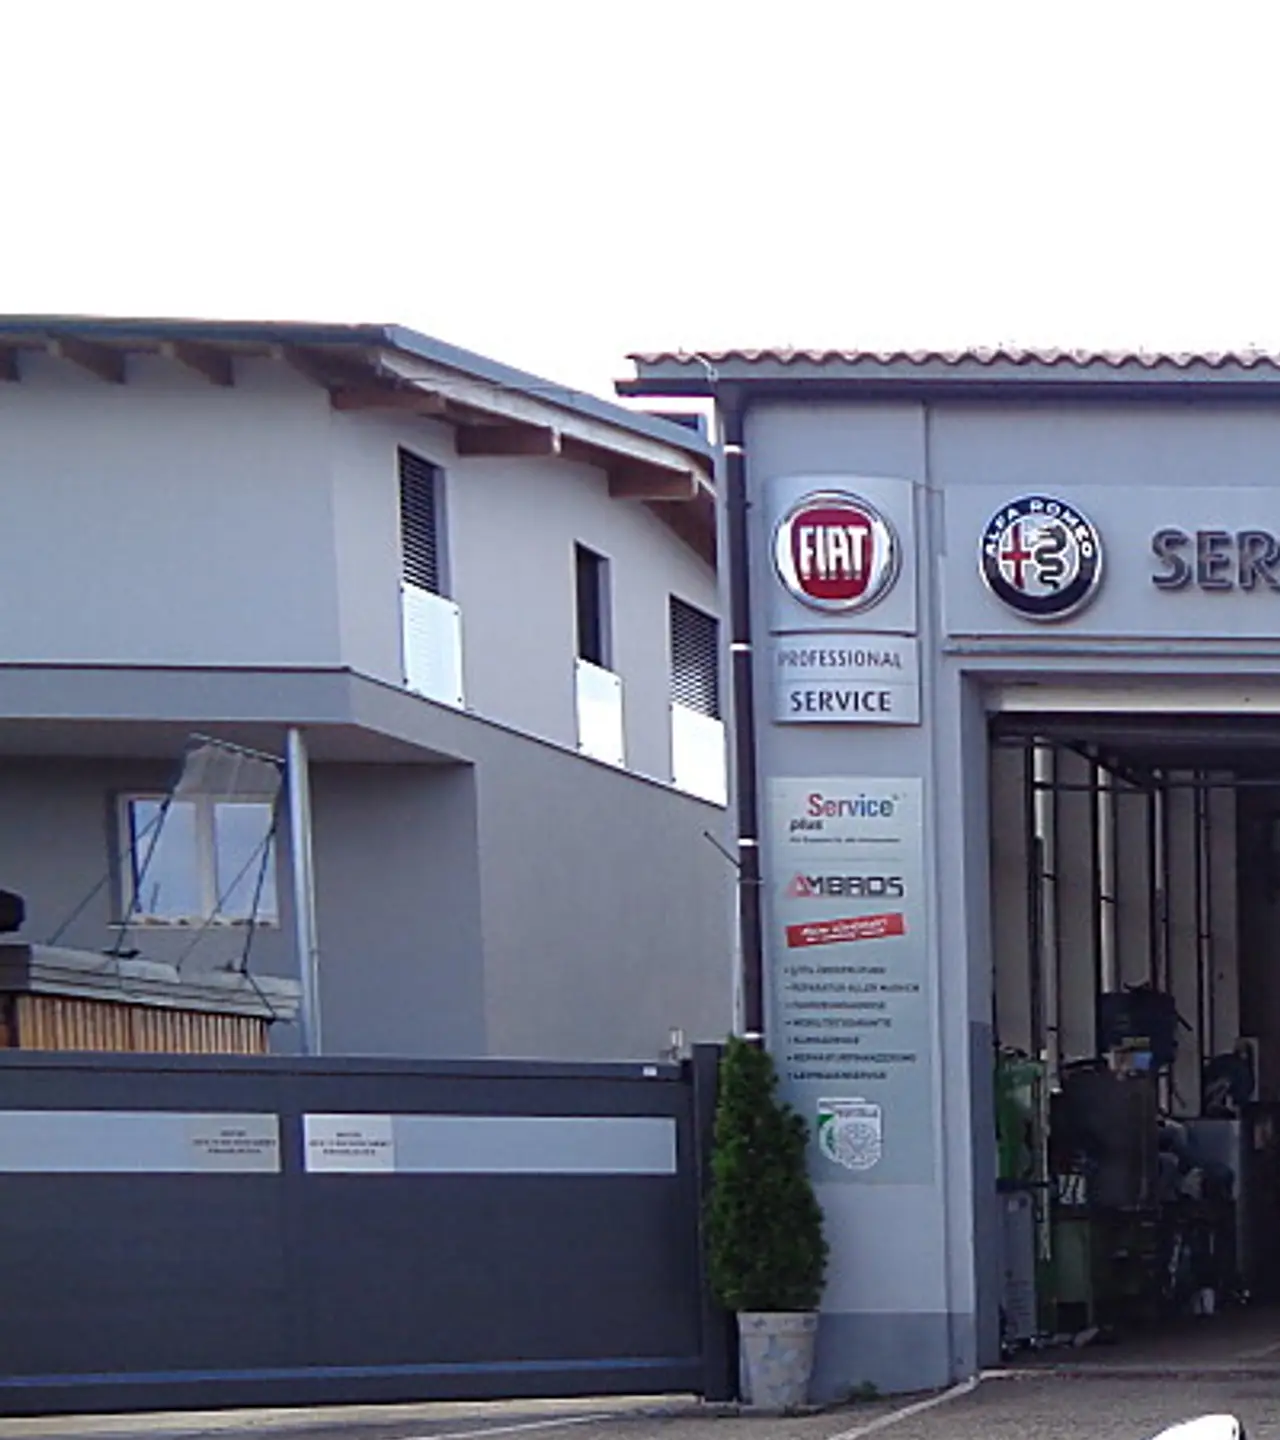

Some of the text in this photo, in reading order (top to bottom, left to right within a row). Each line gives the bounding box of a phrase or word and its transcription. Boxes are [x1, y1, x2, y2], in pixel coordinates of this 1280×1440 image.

[985, 500, 1093, 558] ALFA ROMEO
[799, 524, 868, 581] FIAT
[777, 650, 902, 669] PROFESSIONAL
[790, 690, 892, 713] SERVICE
[807, 792, 895, 818] Service
[785, 872, 905, 898] AMBROS
